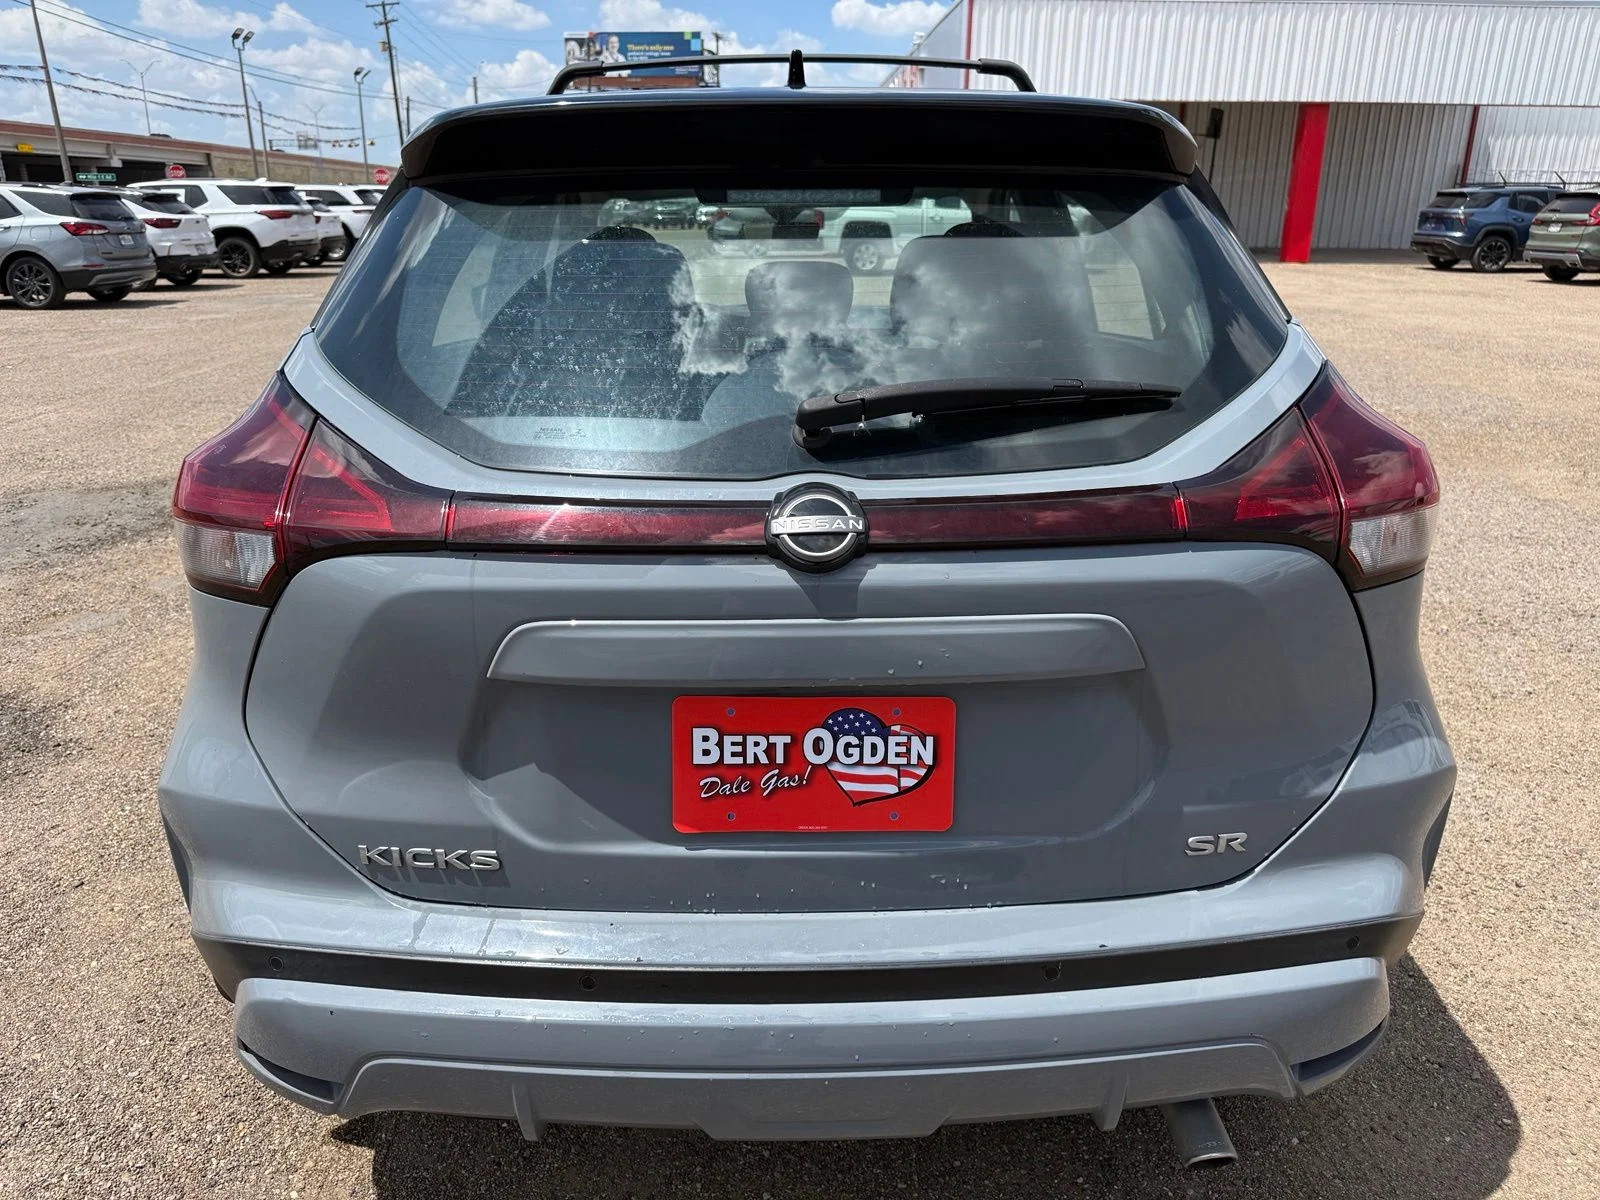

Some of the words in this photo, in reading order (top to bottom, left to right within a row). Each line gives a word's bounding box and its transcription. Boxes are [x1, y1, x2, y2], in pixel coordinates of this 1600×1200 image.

[772, 518, 864, 533] NISSAN
[692, 727, 792, 766] BERT
[803, 727, 935, 766] OGDEN
[700, 776, 751, 799] Dale
[760, 765, 812, 797] Gas!
[357, 844, 500, 871] KICKS
[1184, 832, 1248, 856] SR
